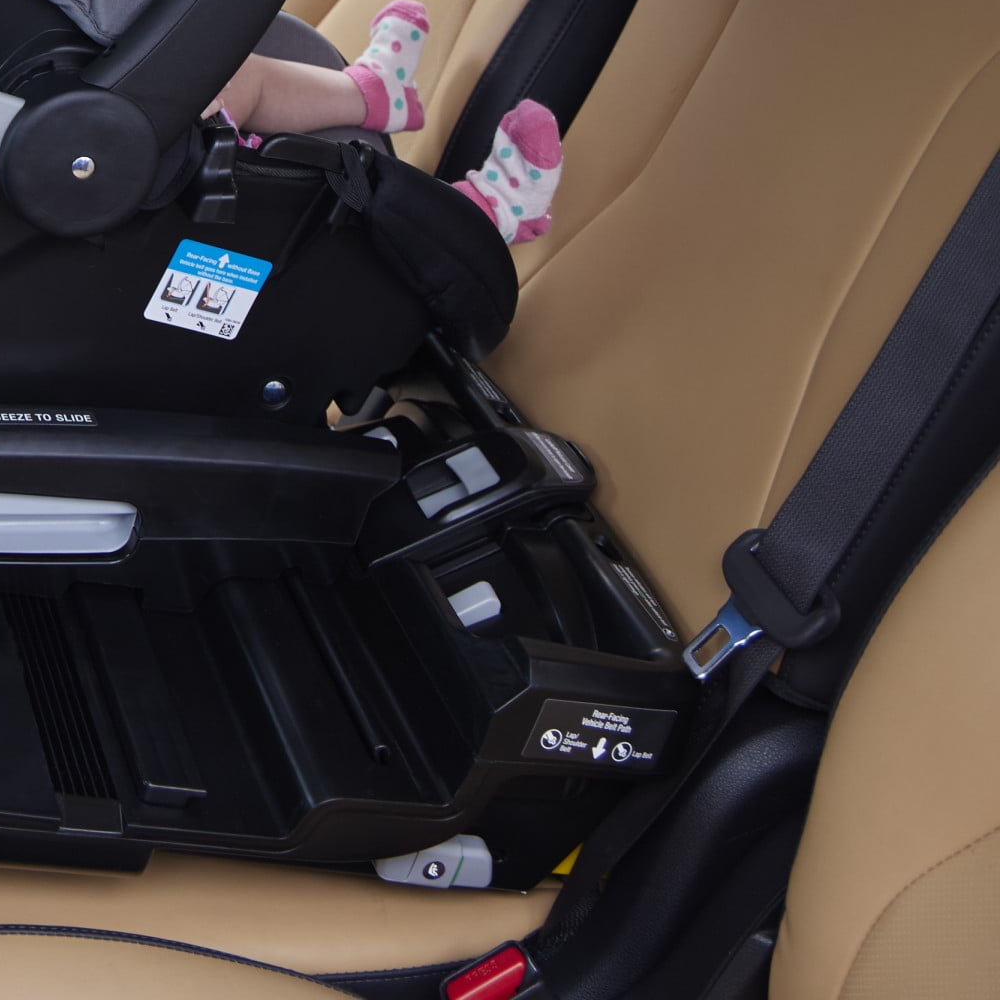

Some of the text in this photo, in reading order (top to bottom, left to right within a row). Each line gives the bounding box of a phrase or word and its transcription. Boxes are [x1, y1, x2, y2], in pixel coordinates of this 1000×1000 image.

[185, 251, 260, 276] Rear-Facing without Base
[56, 414, 92, 422] SLIDE
[591, 709, 629, 725] Rear-Facing
[581, 716, 632, 733] Vehicle Belt Path
[565, 731, 579, 740] Lap/
[562, 737, 587, 748] Shoulder
